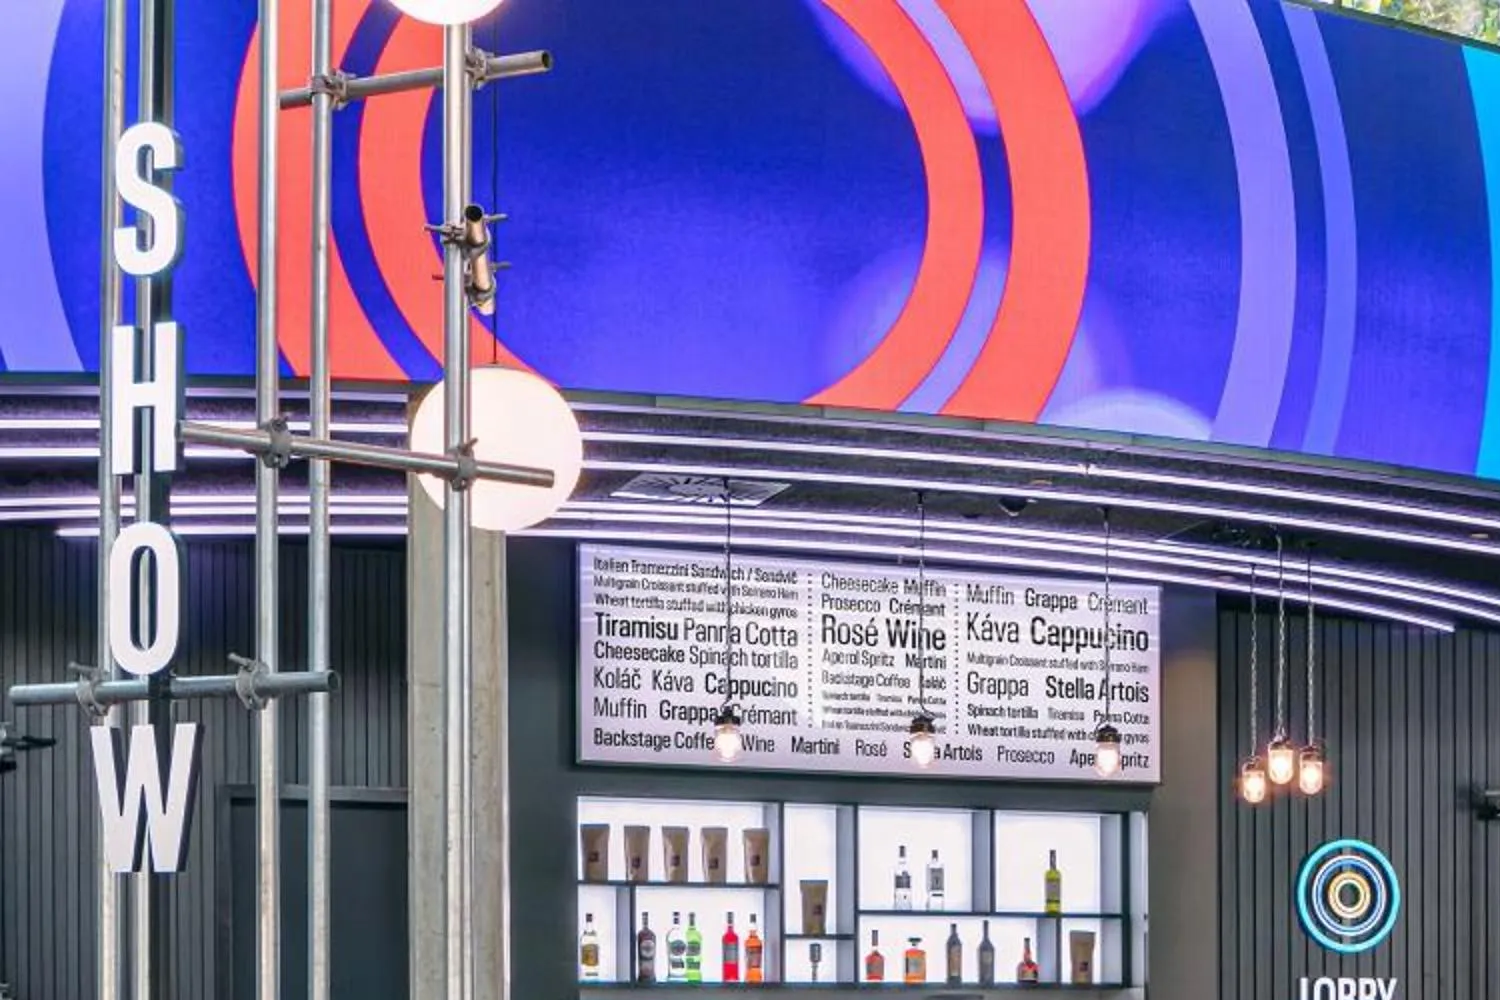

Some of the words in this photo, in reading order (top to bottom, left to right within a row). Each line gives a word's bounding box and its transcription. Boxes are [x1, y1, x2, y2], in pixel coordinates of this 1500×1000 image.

[91, 121, 200, 873] SHOW
[691, 563, 745, 580] Sandwch
[821, 593, 881, 613] Prosecco
[967, 583, 1015, 606] Muffin
[1024, 587, 1078, 613] Grappa
[594, 611, 679, 641] Tiramisu
[745, 621, 799, 647] Cotta
[821, 613, 879, 647] Rosé
[885, 617, 947, 651] Wine
[966, 611, 1020, 644] Káva
[1030, 615, 1150, 655] Cappucino
[593, 639, 685, 663] Cheesecake
[751, 649, 799, 670] tortilla
[593, 665, 642, 691] Koláč
[651, 668, 694, 693] Káva
[705, 671, 799, 701] Cappucino
[966, 670, 1030, 700] Grappa
[1045, 675, 1096, 700] Stella
[1097, 678, 1150, 704] Artois
[593, 696, 648, 719] Muffin
[659, 699, 719, 727] Grappa
[593, 727, 672, 753] Backstage
[674, 730, 716, 751] Coffe
[740, 733, 776, 753] Wine
[791, 735, 840, 756] Martini
[855, 739, 888, 758] Rosé
[943, 743, 983, 762] Artois
[997, 744, 1056, 765] Prosecco
[1119, 751, 1150, 771] pritz
